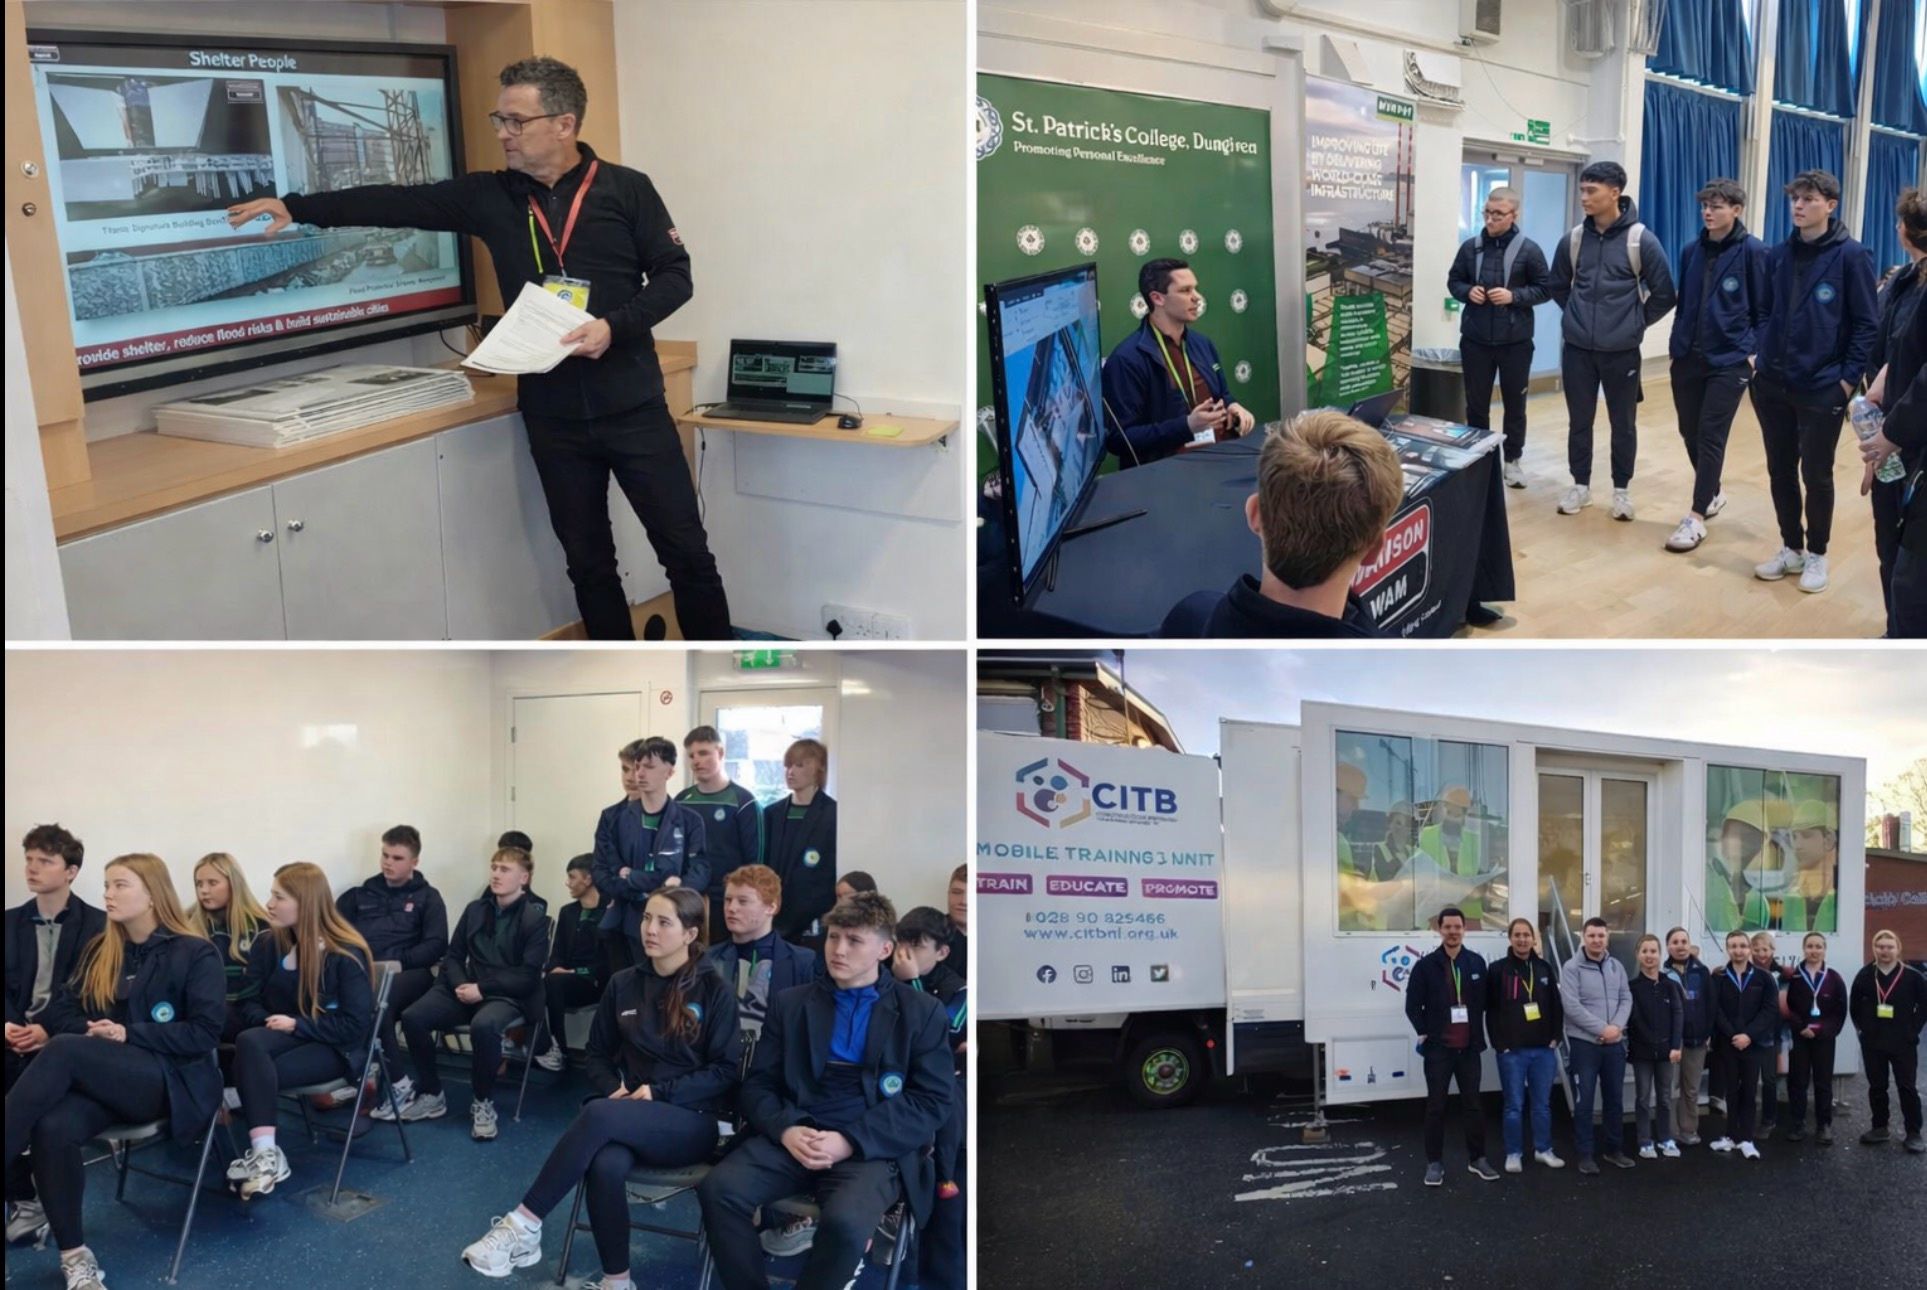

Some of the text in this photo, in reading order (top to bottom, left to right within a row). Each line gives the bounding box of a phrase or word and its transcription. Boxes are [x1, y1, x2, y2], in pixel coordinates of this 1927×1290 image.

[189, 51, 297, 73] Shelter People
[1011, 111, 1039, 134] St.
[1042, 115, 1122, 143] Patrick's
[1124, 126, 1190, 151] College,
[1014, 140, 1072, 159] Promoting
[1092, 783, 1178, 814] CITB
[977, 841, 1059, 860] MOBILE
[977, 877, 1028, 891] TRAIN
[1049, 879, 1127, 894] EDUCATE
[1035, 911, 1070, 924] 028
[1076, 912, 1098, 924] 90
